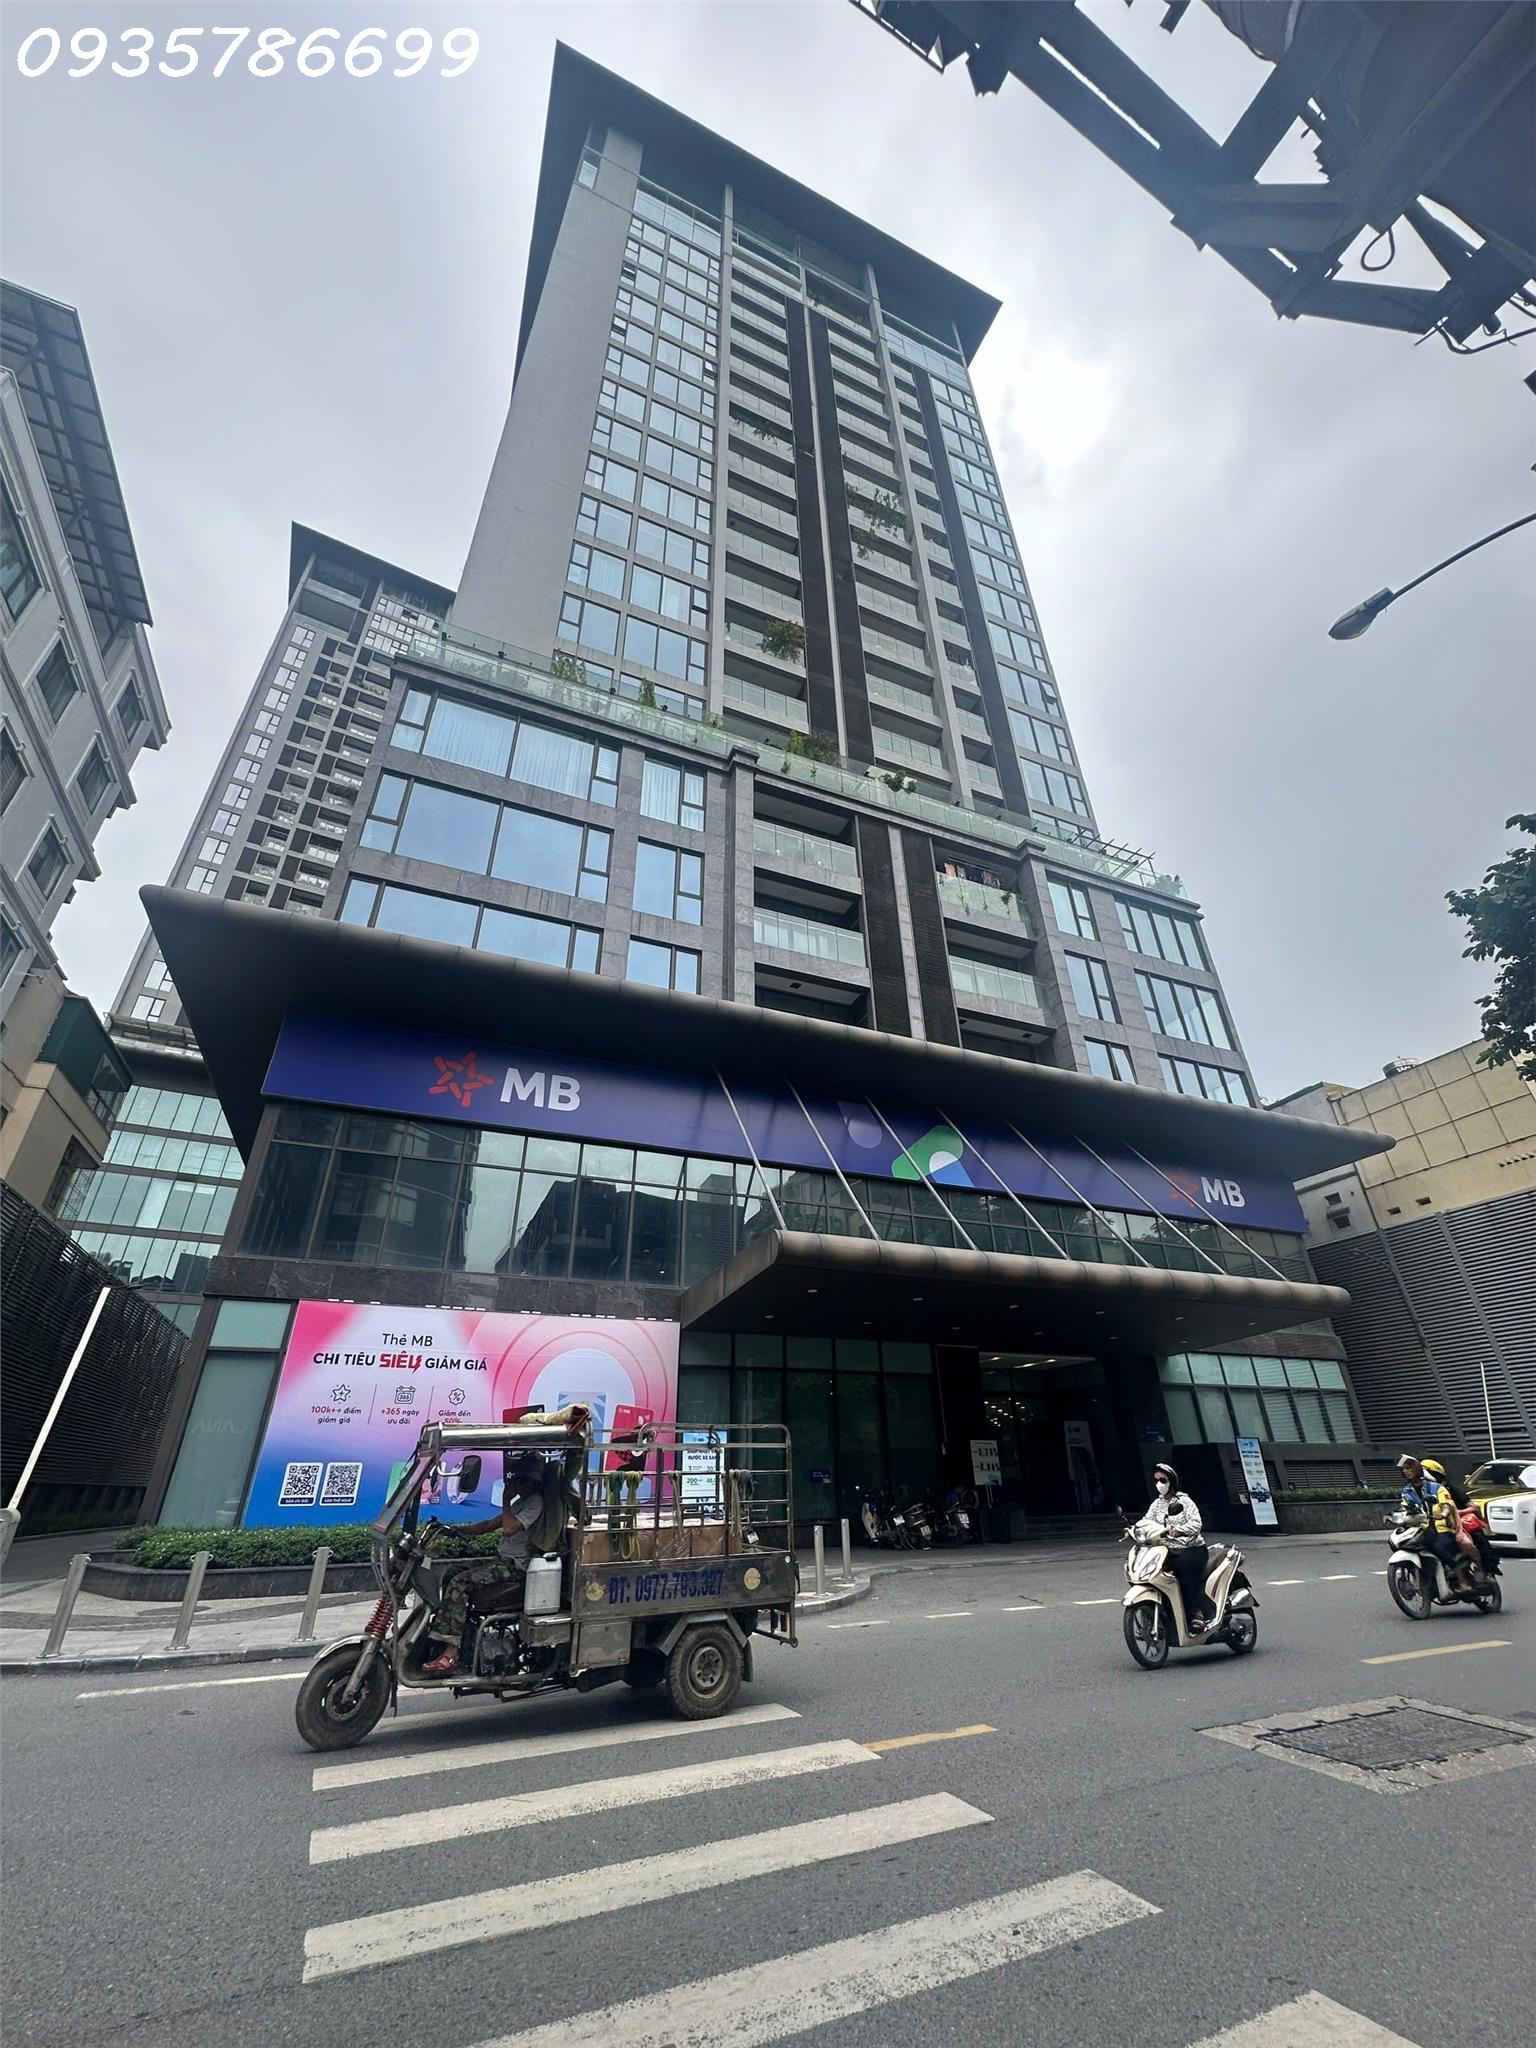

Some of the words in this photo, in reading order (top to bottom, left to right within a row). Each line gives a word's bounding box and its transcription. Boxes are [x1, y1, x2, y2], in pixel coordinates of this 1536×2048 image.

[500, 1067, 581, 1112] MB
[1201, 1176, 1246, 1207] MB
[382, 1333, 407, 1346] Thẻ
[411, 1335, 433, 1347] MB
[313, 1352, 340, 1365] CHI
[344, 1351, 375, 1366] TIÊU
[425, 1355, 461, 1371] GIẢM
[464, 1357, 488, 1371] GIÁ
[381, 1407, 400, 1415] +365
